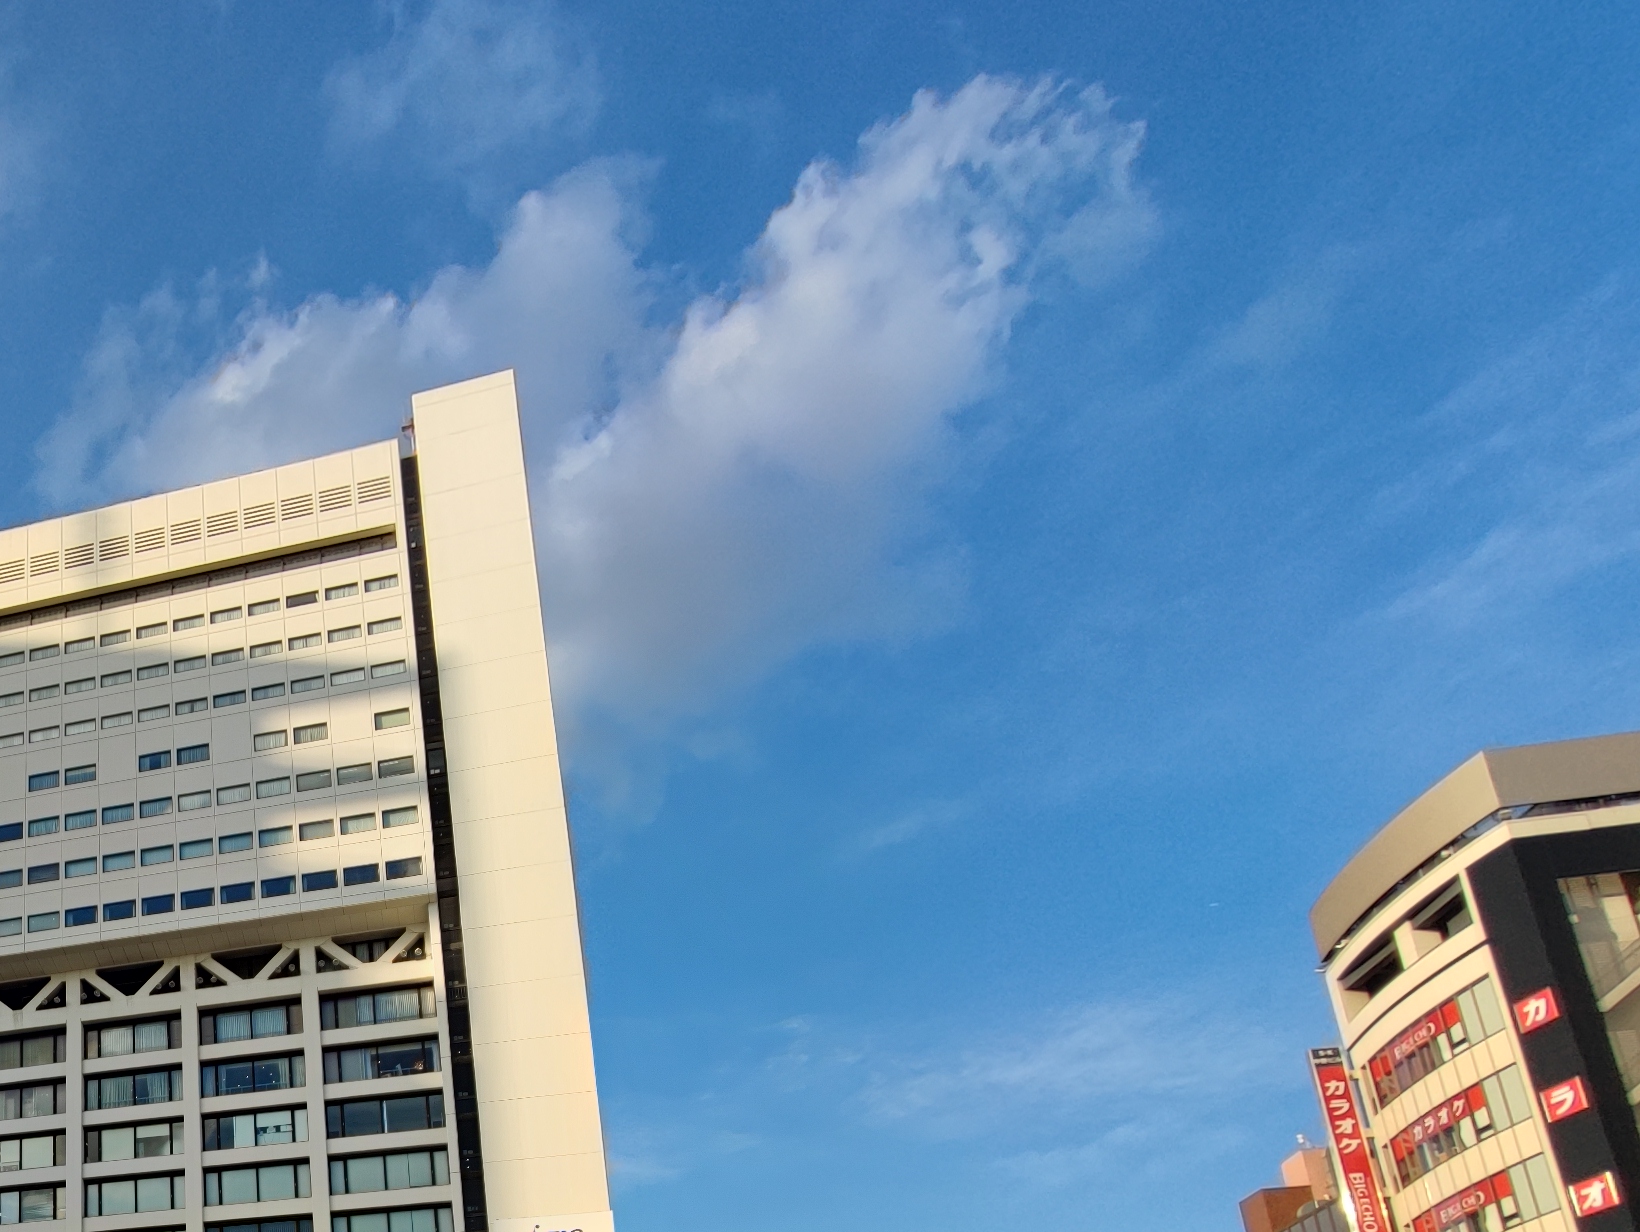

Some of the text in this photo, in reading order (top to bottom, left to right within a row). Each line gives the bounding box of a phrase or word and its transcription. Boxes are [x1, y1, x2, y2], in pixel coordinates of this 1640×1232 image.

[1324, 1080, 1361, 1154] カラオケ
[1413, 1099, 1466, 1142] カラオケ
